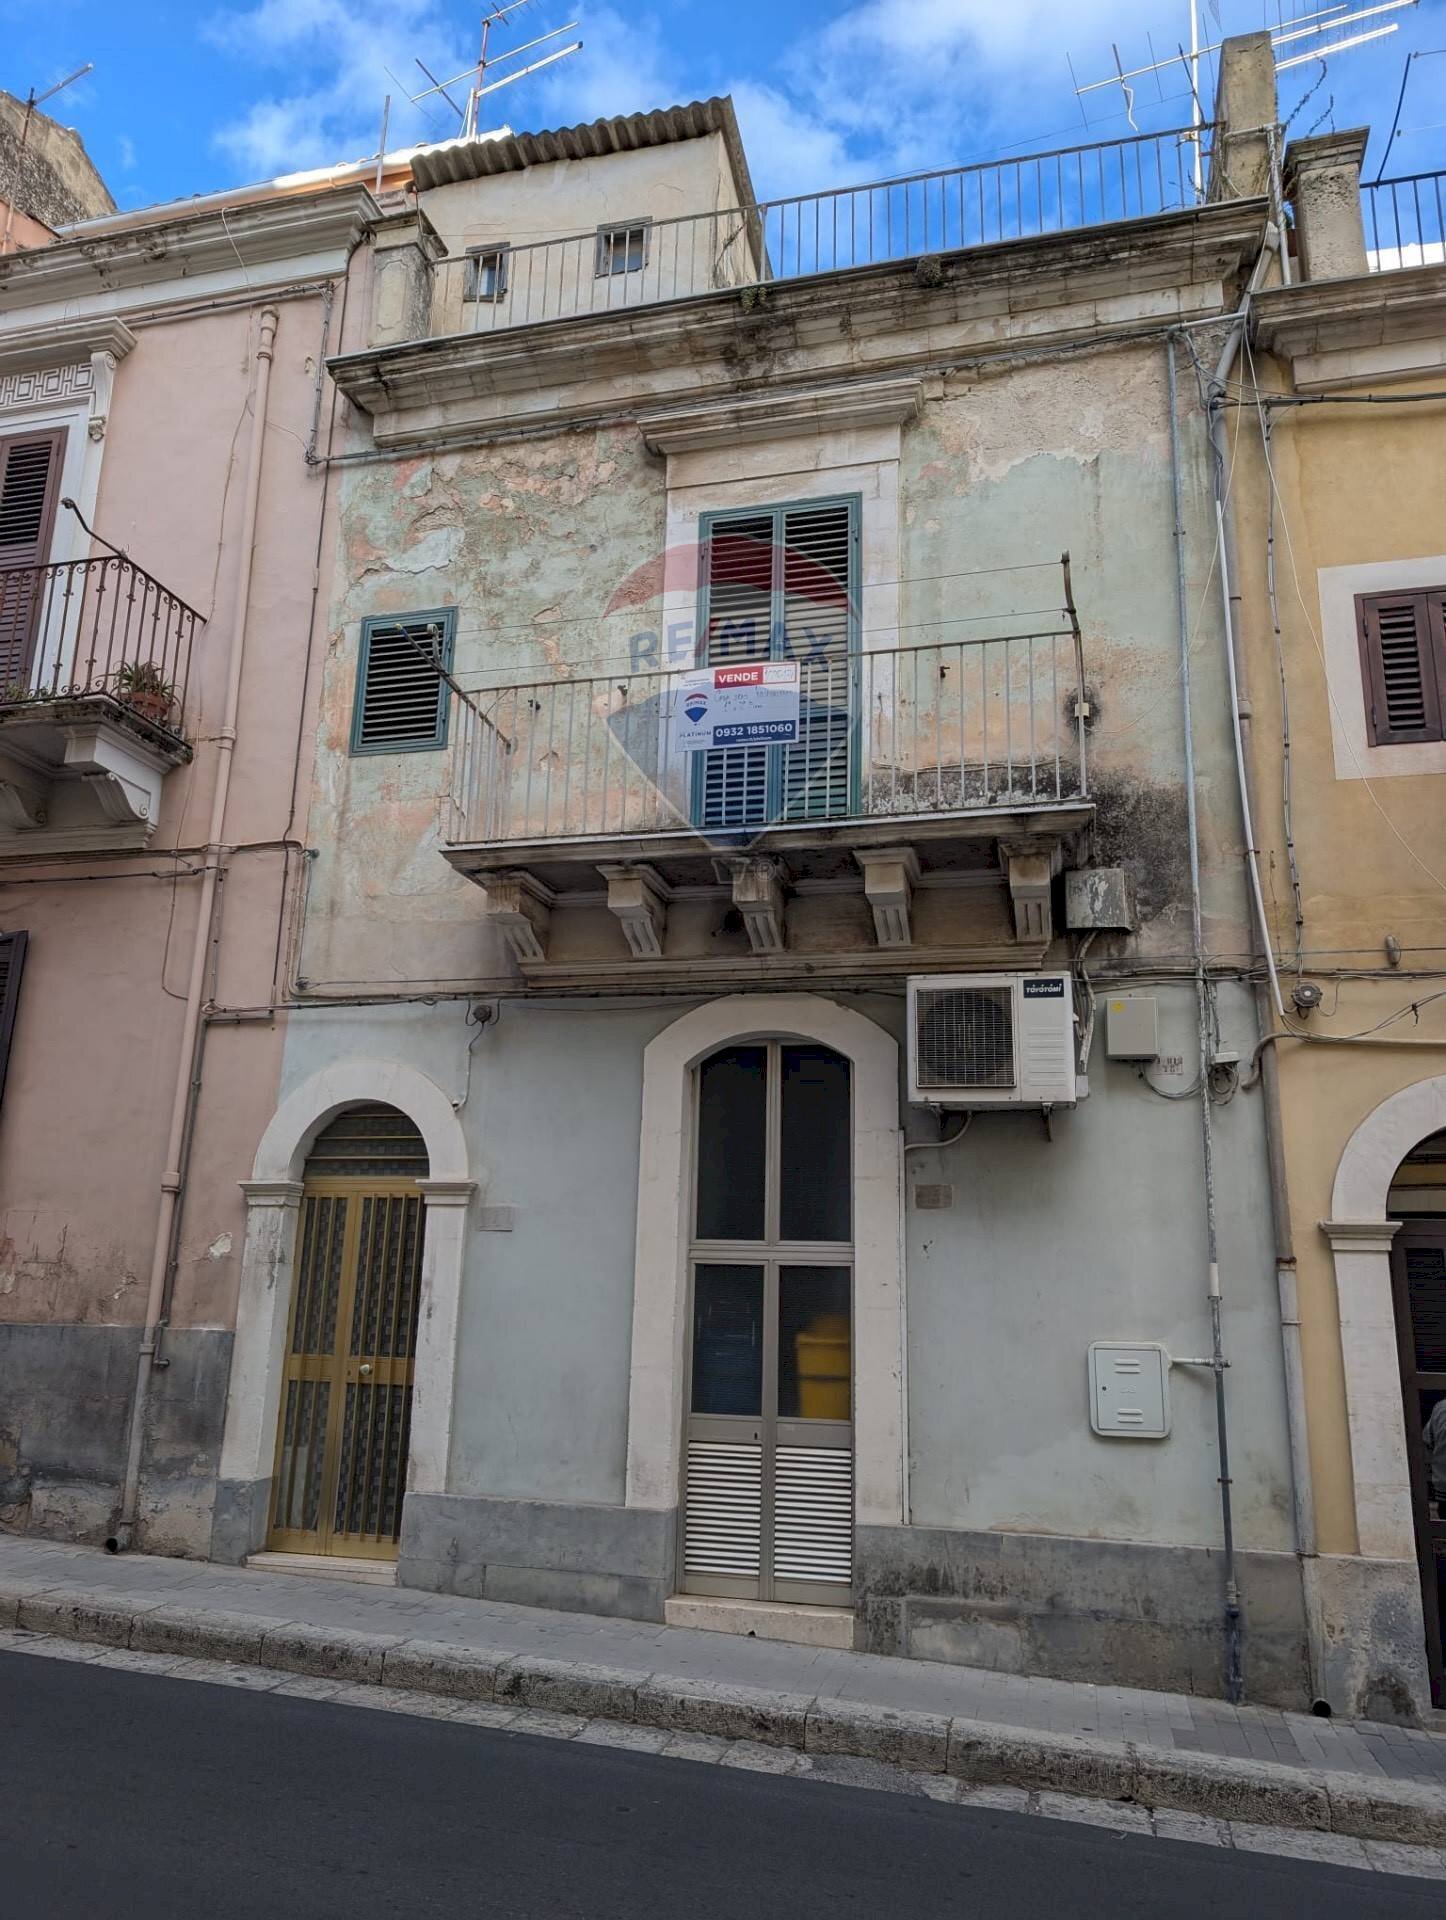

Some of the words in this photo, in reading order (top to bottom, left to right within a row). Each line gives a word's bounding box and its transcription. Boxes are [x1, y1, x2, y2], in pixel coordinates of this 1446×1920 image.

[718, 671, 759, 684] VENDE
[716, 726, 743, 737] 0932
[747, 724, 792, 736] 1851060
